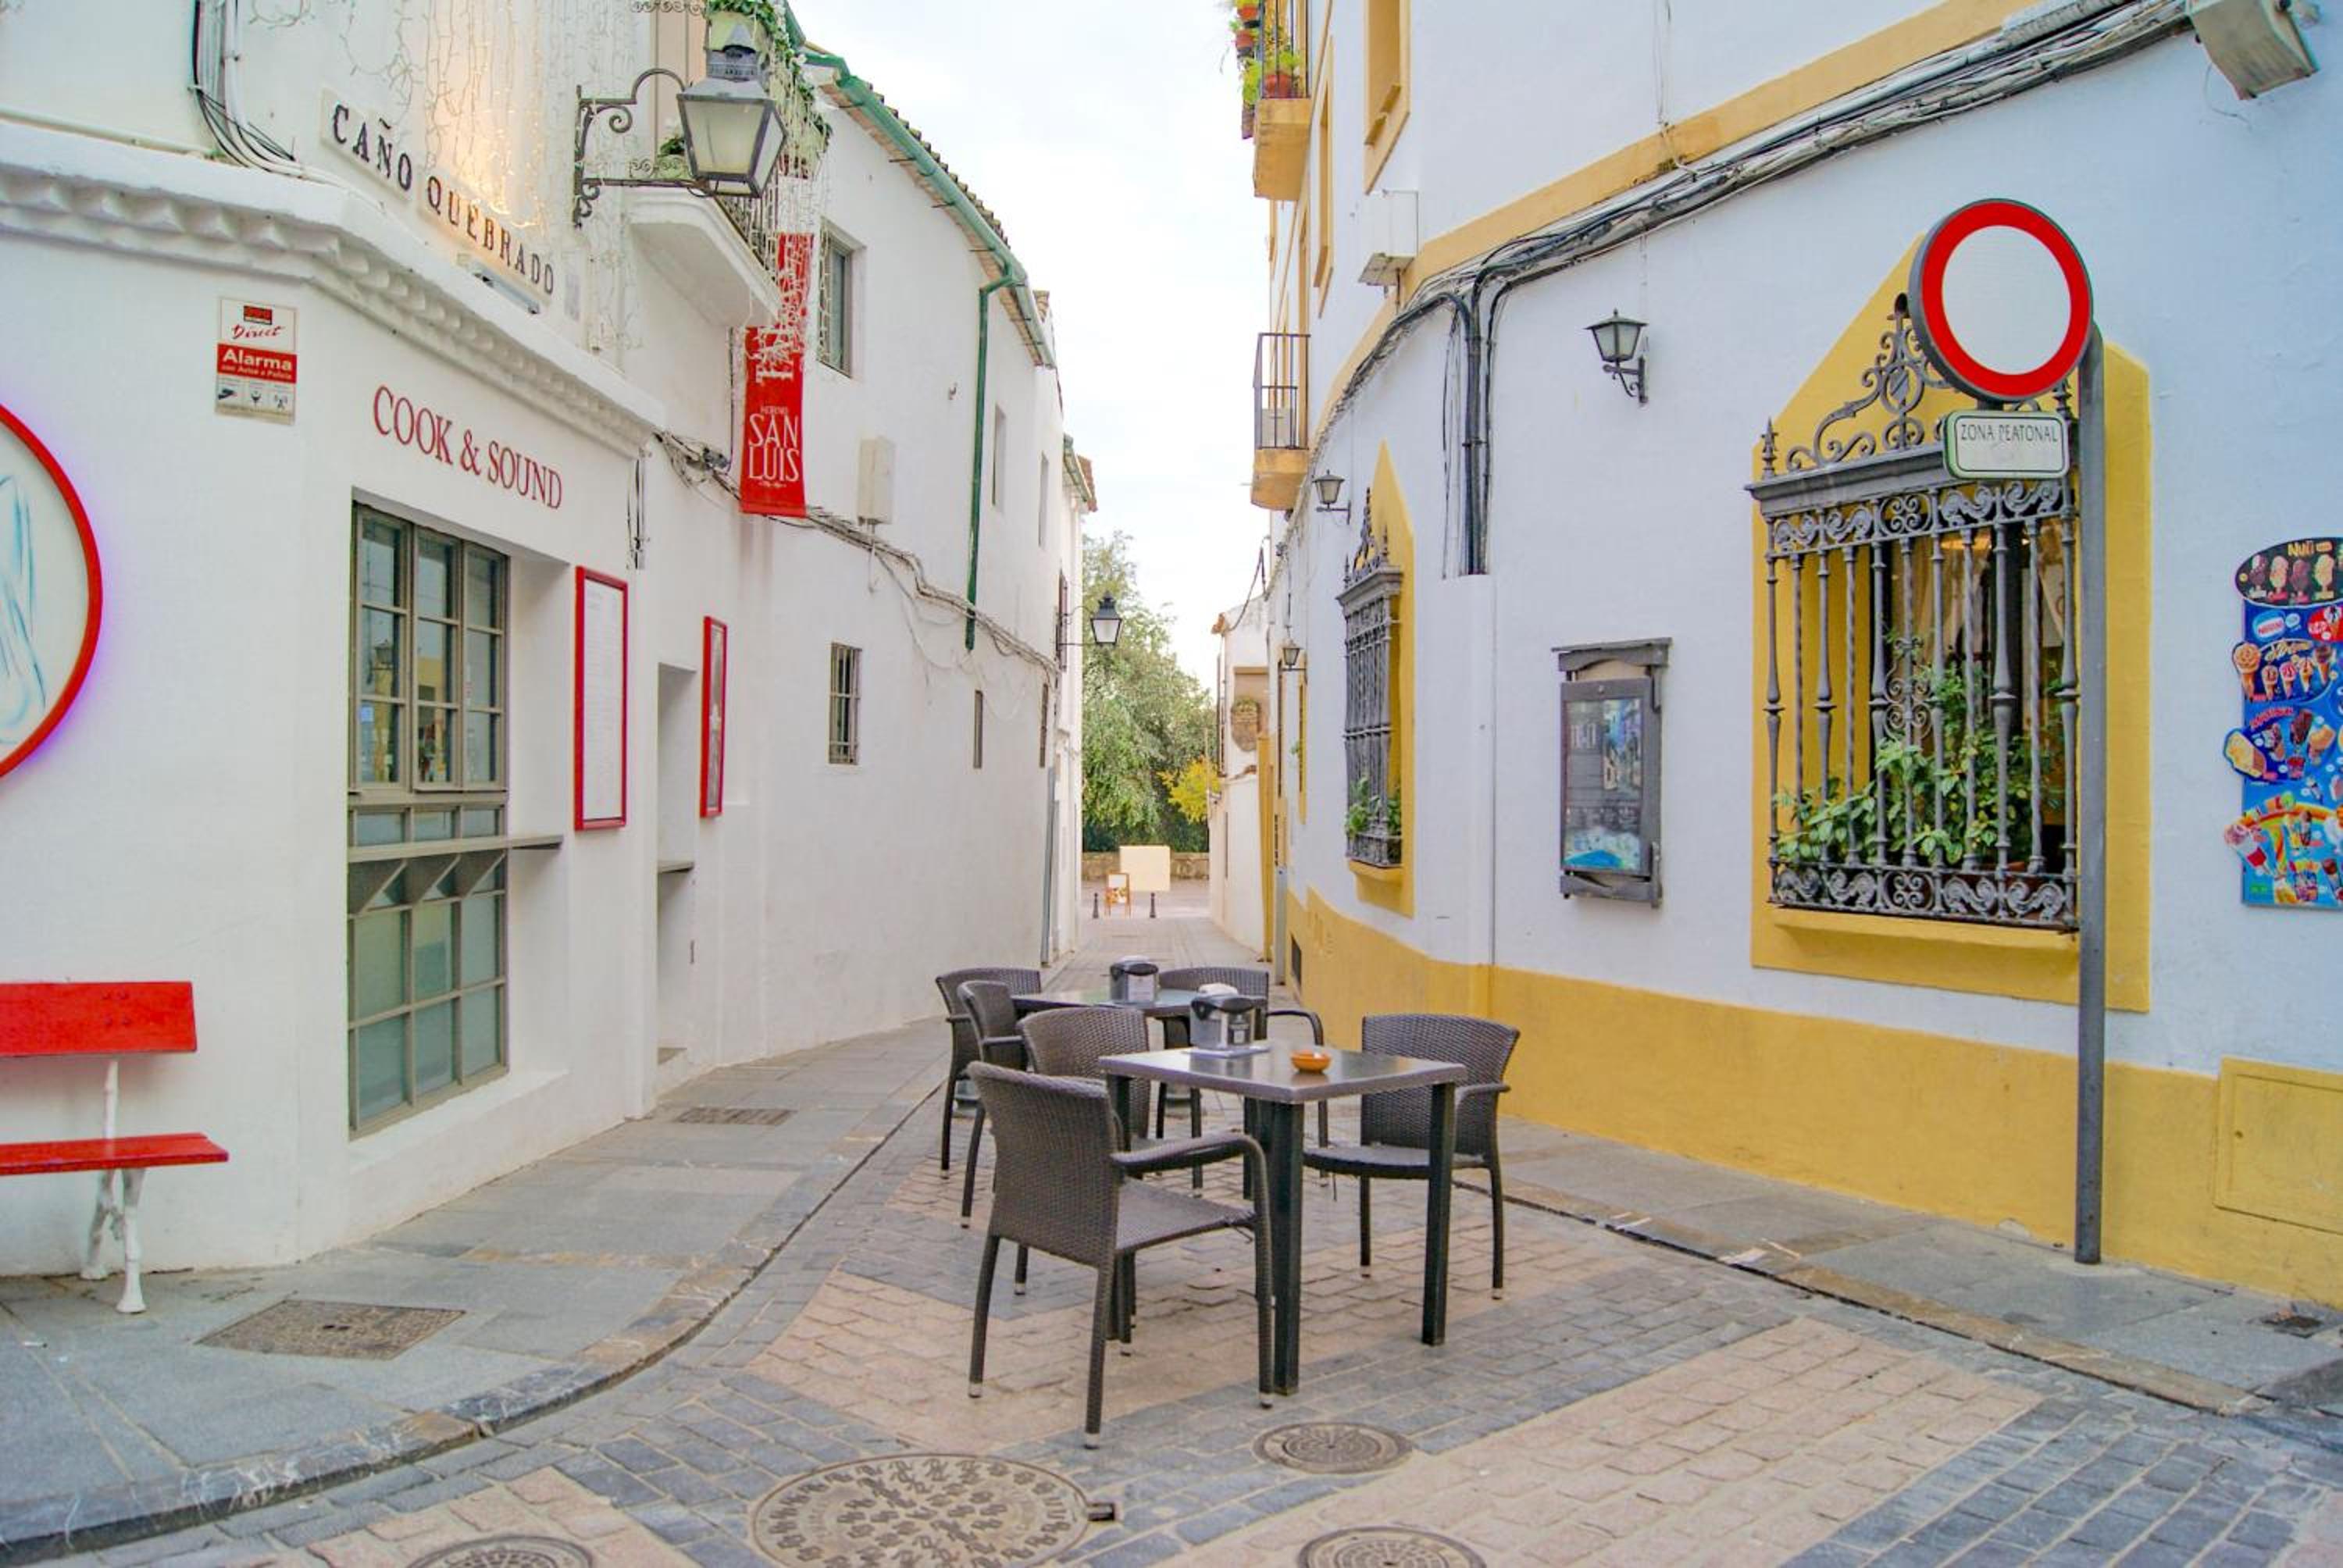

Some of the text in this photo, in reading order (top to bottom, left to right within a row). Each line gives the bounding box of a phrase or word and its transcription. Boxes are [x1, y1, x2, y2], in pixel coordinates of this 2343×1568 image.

[333, 104, 553, 294] CAÑO QUEBRADO
[223, 349, 292, 371] Alarma
[373, 385, 562, 509] COOK & SOUND
[747, 413, 798, 448] SAN
[1961, 424, 2058, 442] ZONA PEATONAL
[747, 446, 800, 482] LUIS
